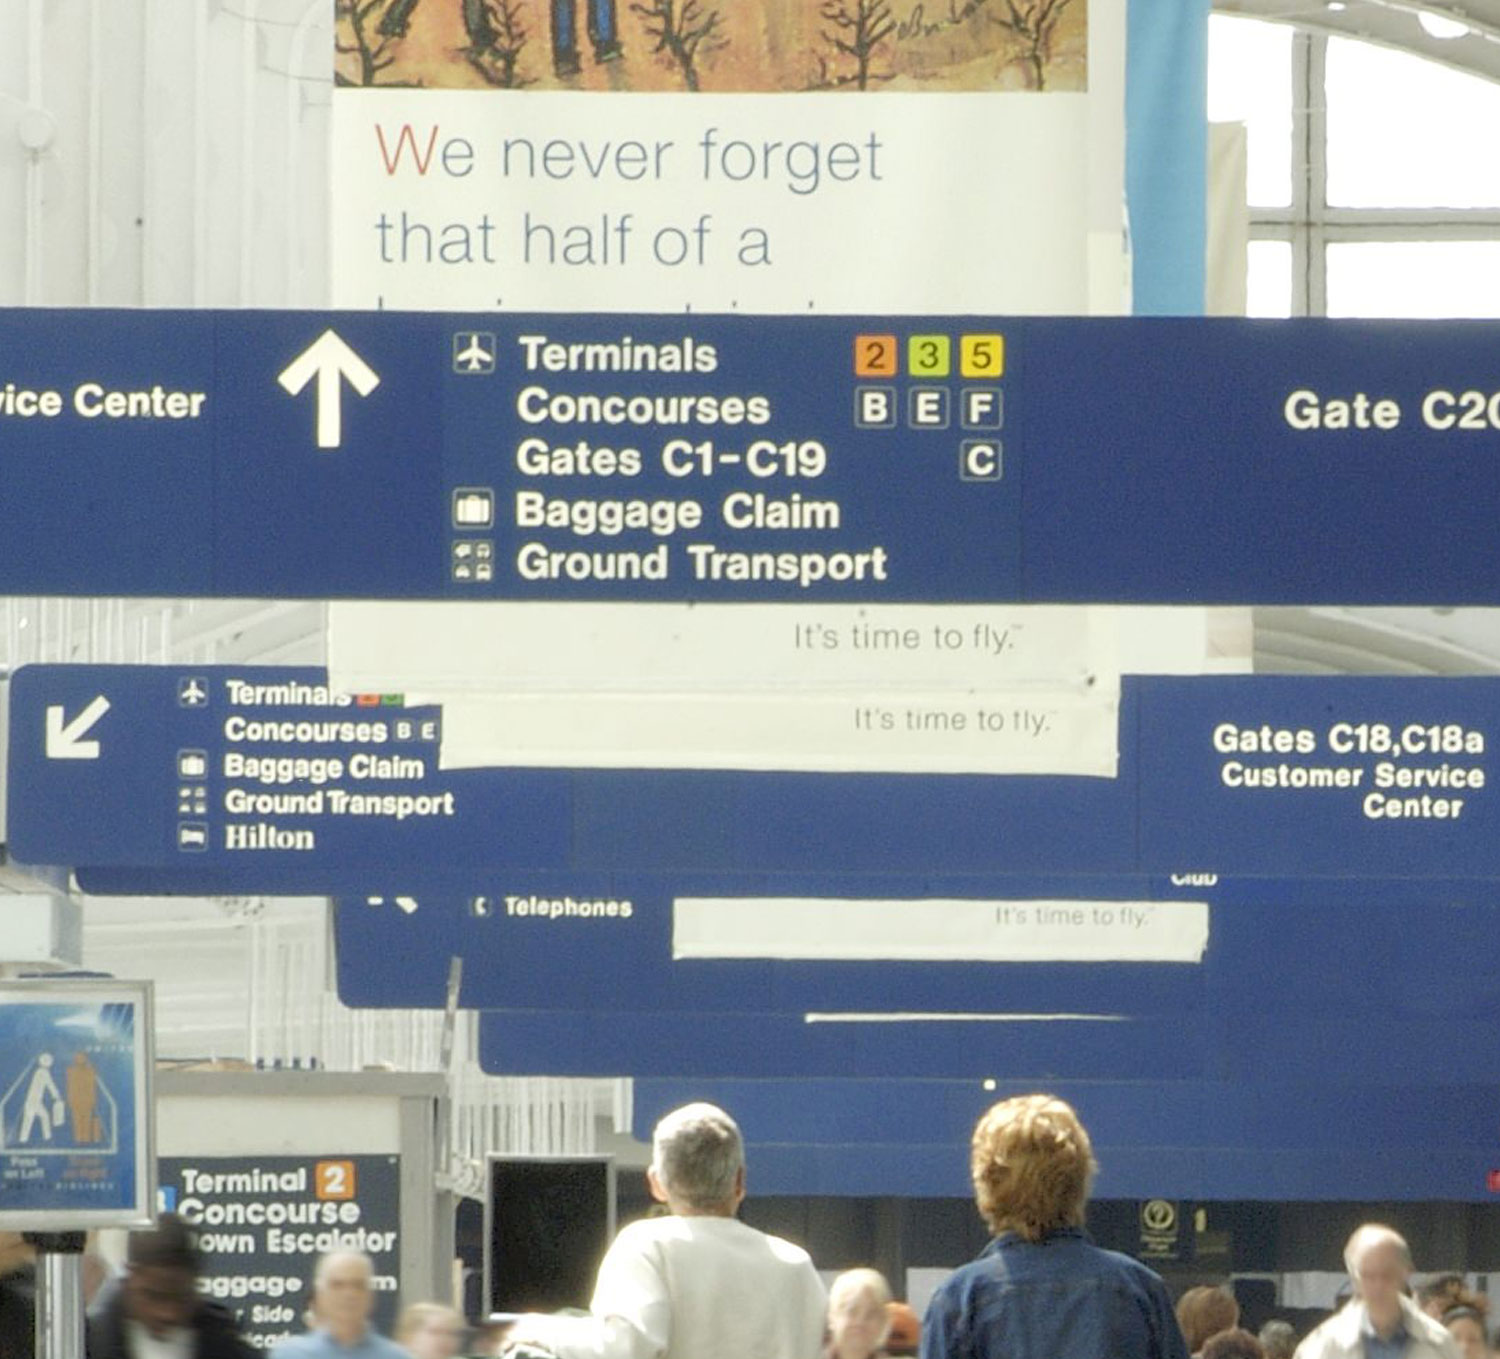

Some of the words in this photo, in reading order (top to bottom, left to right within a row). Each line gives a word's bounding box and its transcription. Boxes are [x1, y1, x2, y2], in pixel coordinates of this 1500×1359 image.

[376, 124, 476, 179] We
[504, 138, 675, 181] never
[700, 128, 884, 196] forget
[376, 212, 497, 266] that
[525, 213, 634, 266] half
[654, 214, 713, 267] of
[738, 228, 773, 267] a
[519, 336, 719, 374] Terminals
[866, 341, 886, 370] 2
[919, 341, 940, 369] 3
[971, 341, 992, 370] 5
[75, 384, 207, 419] Center
[518, 388, 771, 426] Concourses
[862, 391, 889, 423] B
[916, 391, 941, 424] E
[969, 392, 994, 424] F
[1285, 391, 1402, 431] Gate
[517, 440, 642, 477] Gates
[966, 444, 995, 476] C
[517, 493, 703, 536] Baggage
[723, 493, 841, 530] Claim
[518, 544, 668, 581] Ground
[688, 545, 888, 587] Transport
[796, 624, 839, 650] It's
[853, 624, 921, 650] time
[934, 626, 964, 650] to
[225, 717, 388, 743] Concourses
[397, 722, 412, 739] B
[421, 722, 435, 740] E
[855, 708, 896, 731] It's
[907, 709, 967, 732] time
[978, 710, 1005, 732] to
[1214, 724, 1317, 755] Gates
[1329, 724, 1485, 758] C18,C18a
[225, 753, 344, 785] Baggage
[349, 754, 425, 780] Claim
[1222, 762, 1365, 789] Customer
[1376, 763, 1486, 790] Service
[226, 789, 323, 815] Ground
[326, 790, 455, 820] Transport
[1363, 792, 1465, 820] Center
[227, 823, 315, 851] Hilton
[505, 896, 634, 919] Telephones
[996, 907, 1028, 926] It's
[1036, 908, 1085, 926] time
[1093, 908, 1116, 926] to
[181, 1168, 307, 1194] Terminal
[323, 1165, 347, 1195] 2
[178, 1198, 361, 1225] Concourse
[190, 1231, 256, 1253] own
[266, 1227, 398, 1253] Escalator
[193, 1275, 303, 1298] aggage
[251, 1305, 296, 1324] Side
